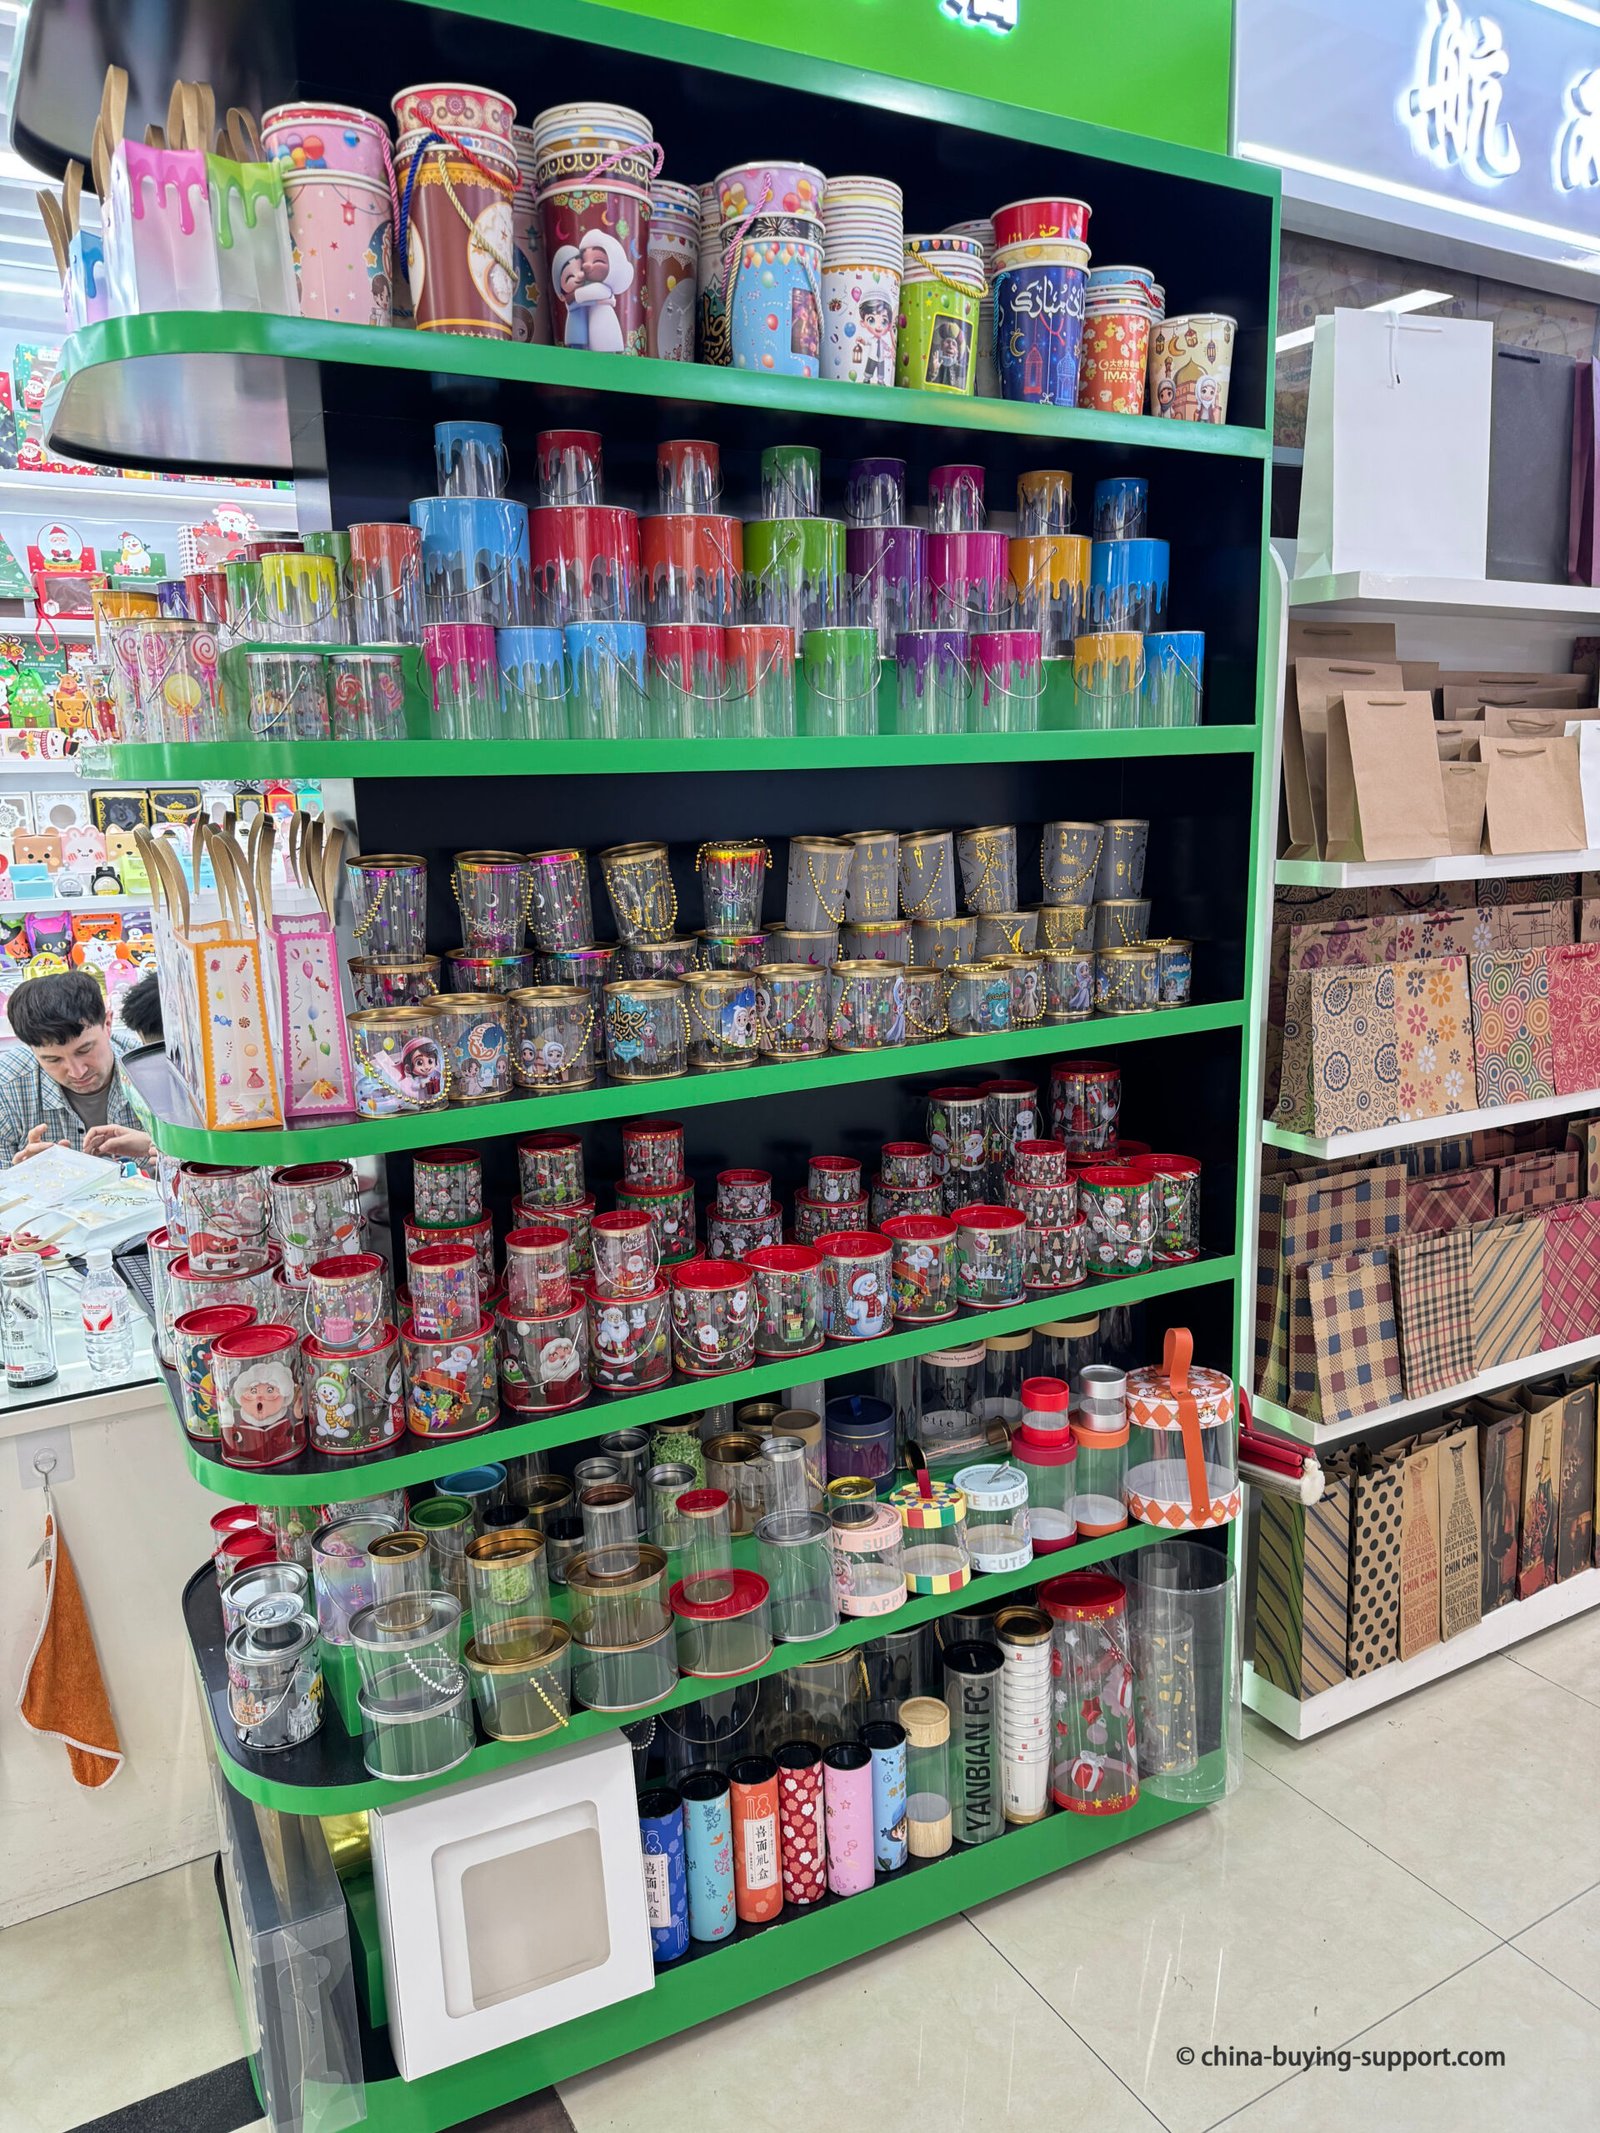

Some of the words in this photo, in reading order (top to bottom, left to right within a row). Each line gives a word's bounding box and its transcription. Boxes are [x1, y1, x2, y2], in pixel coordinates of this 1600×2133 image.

[1103, 371, 1136, 380] IMAX
[990, 1554, 1026, 1571] CUTE
[1444, 1542, 1478, 1563] CHEERS
[1445, 1558, 1460, 1576] CHIN
[1462, 1551, 1478, 1568] CHIN
[1403, 1560, 1437, 1580] CHEERS
[1403, 1579, 1419, 1595] CHIN
[1420, 1568, 1437, 1586] CHIN
[964, 1685, 990, 1715] FC
[964, 1723, 991, 1832] YANBIAN
